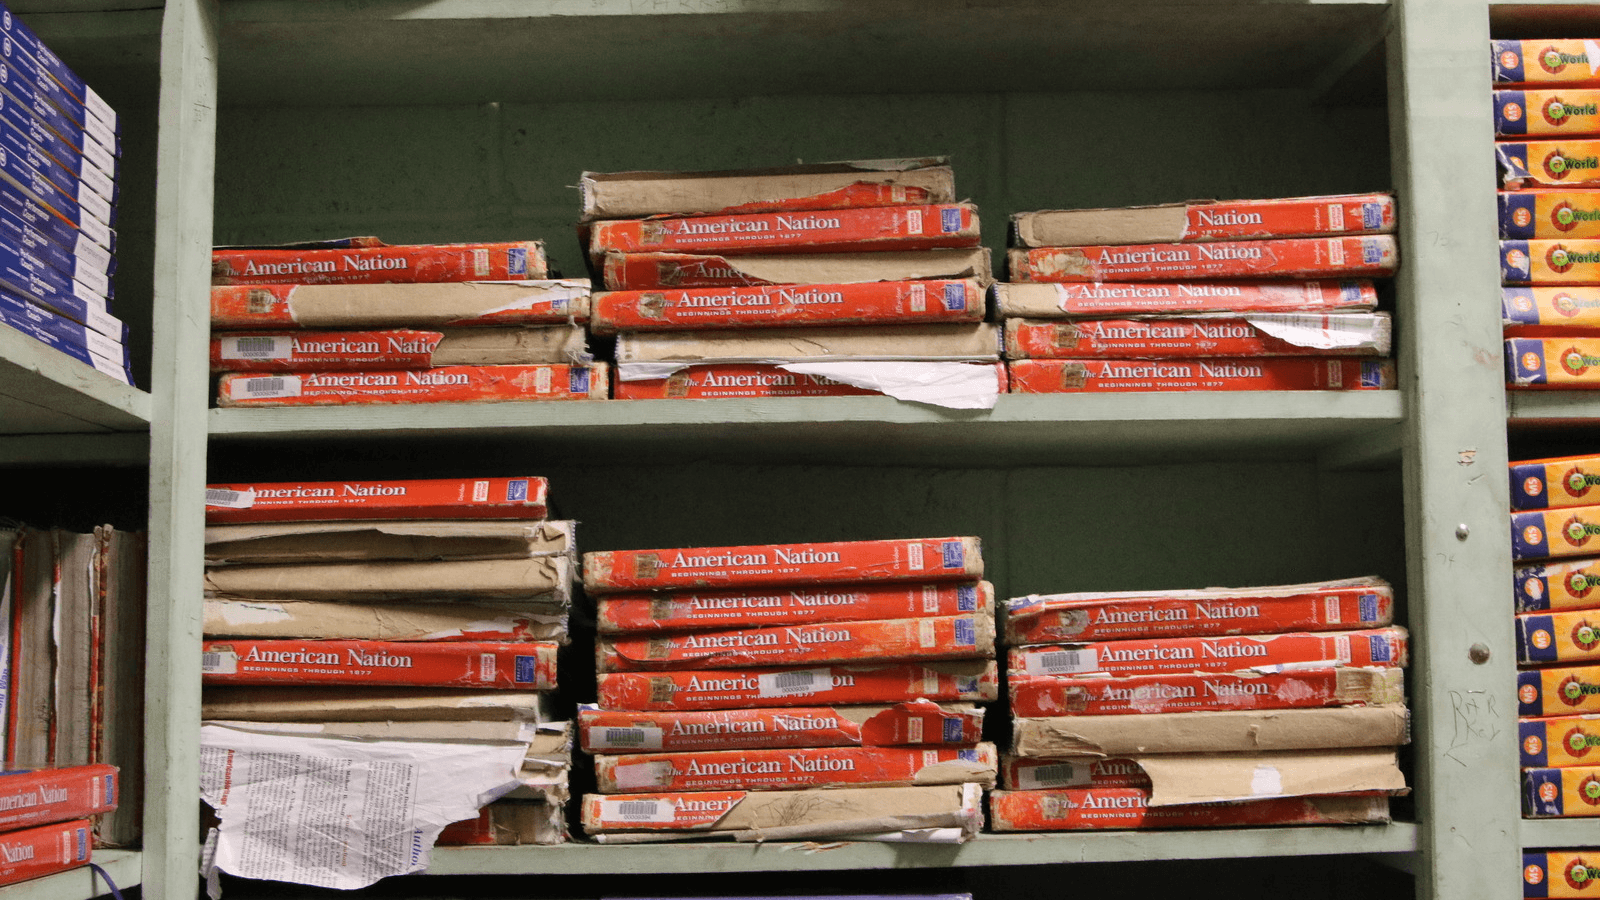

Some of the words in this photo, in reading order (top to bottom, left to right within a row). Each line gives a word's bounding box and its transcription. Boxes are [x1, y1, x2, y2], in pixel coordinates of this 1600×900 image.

[1505, 53, 1515, 68] MS
[1508, 104, 1518, 120] MS
[1564, 104, 1597, 116] World
[1564, 156, 1597, 169] World
[658, 226, 674, 235] The
[676, 219, 769, 236] American
[776, 215, 841, 231] Nation
[1197, 210, 1262, 226] Nation
[1517, 209, 1527, 225] MS
[1098, 248, 1191, 265] American
[1197, 244, 1262, 261] Nation
[1567, 252, 1600, 263] World
[244, 258, 336, 276] American
[343, 254, 407, 272] Nation
[659, 300, 675, 308] The
[677, 291, 770, 308] American
[778, 289, 843, 305] Nation
[1078, 284, 1170, 299] American
[1178, 284, 1241, 297] Nation
[1074, 331, 1090, 339] The
[1093, 322, 1185, 340] American
[1192, 322, 1256, 338] Nation
[291, 338, 379, 353] American
[387, 336, 438, 354] Natio
[1081, 370, 1096, 378] The
[1099, 362, 1192, 379] American
[1199, 360, 1262, 378] Nation
[1526, 354, 1537, 370] MS
[304, 372, 398, 387] American
[405, 370, 469, 386] Nation
[684, 378, 699, 387] The
[702, 371, 795, 387] American
[247, 485, 335, 498] American
[343, 484, 406, 497] Nation
[1528, 478, 1538, 495] MS
[1528, 528, 1538, 544] MS
[653, 559, 670, 568] The
[672, 551, 767, 569] American
[774, 548, 841, 566] Nation
[689, 594, 782, 610] American
[789, 591, 854, 607] Nation
[1094, 607, 1188, 624] American
[1196, 603, 1259, 618] Nation
[664, 641, 681, 650] The
[683, 631, 778, 649] American
[785, 627, 851, 644] Nation
[1537, 631, 1547, 648] MS
[246, 646, 340, 665] American
[347, 648, 412, 668] Nation
[1099, 645, 1193, 662] American
[1201, 640, 1267, 658] Nation
[668, 684, 685, 693] The
[687, 675, 760, 692] Americ
[1101, 684, 1194, 701] American
[1203, 679, 1269, 697] Nation
[1523, 686, 1533, 702] MS
[670, 720, 765, 737] American
[773, 714, 838, 731] Nation
[1528, 737, 1539, 753] MS
[668, 768, 684, 776] The
[686, 759, 781, 776] American
[788, 755, 855, 772] Nation
[40, 783, 67, 804] Nation
[1062, 801, 1079, 809] The
[1082, 792, 1149, 809] Americ
[1543, 784, 1554, 801] MS
[1, 842, 34, 863] Nation
[1528, 867, 1539, 883] MS
